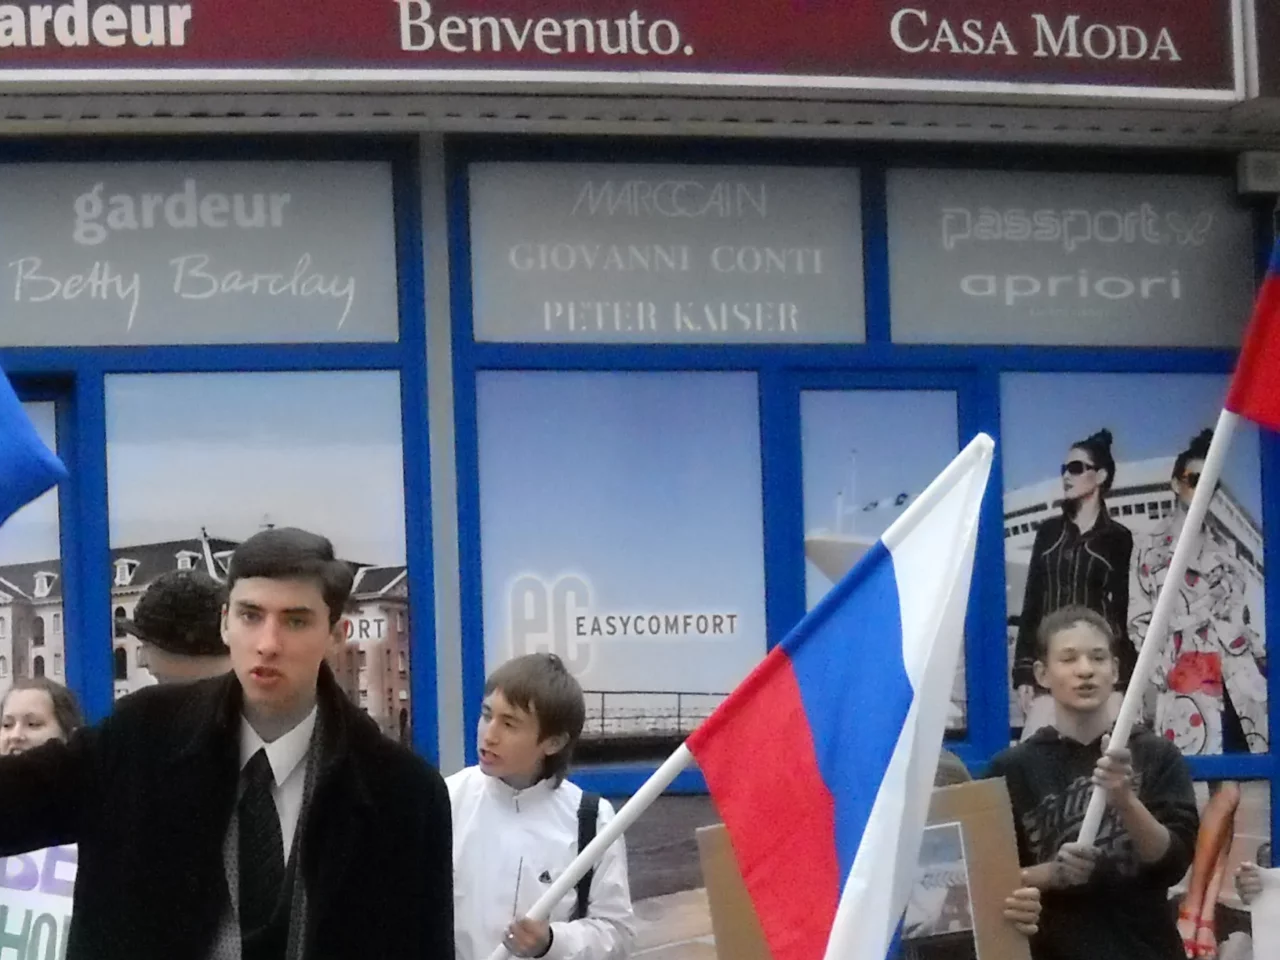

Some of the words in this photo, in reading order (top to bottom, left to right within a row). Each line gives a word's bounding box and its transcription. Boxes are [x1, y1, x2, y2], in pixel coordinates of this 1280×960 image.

[397, 0, 695, 55] Benvenuto.
[890, 8, 1018, 56] CASA
[1031, 13, 1182, 62] MODA
[73, 179, 291, 245] gardeur
[941, 203, 1161, 252] passport
[508, 243, 690, 272] GIOVANNI
[710, 246, 824, 274] CONTI
[9, 256, 140, 333] Betty
[170, 253, 356, 331] Barclay
[960, 269, 1181, 306] apriori
[543, 301, 657, 331] PETER
[673, 302, 799, 333] KAISER
[576, 614, 738, 636] EASYCOMFORT
